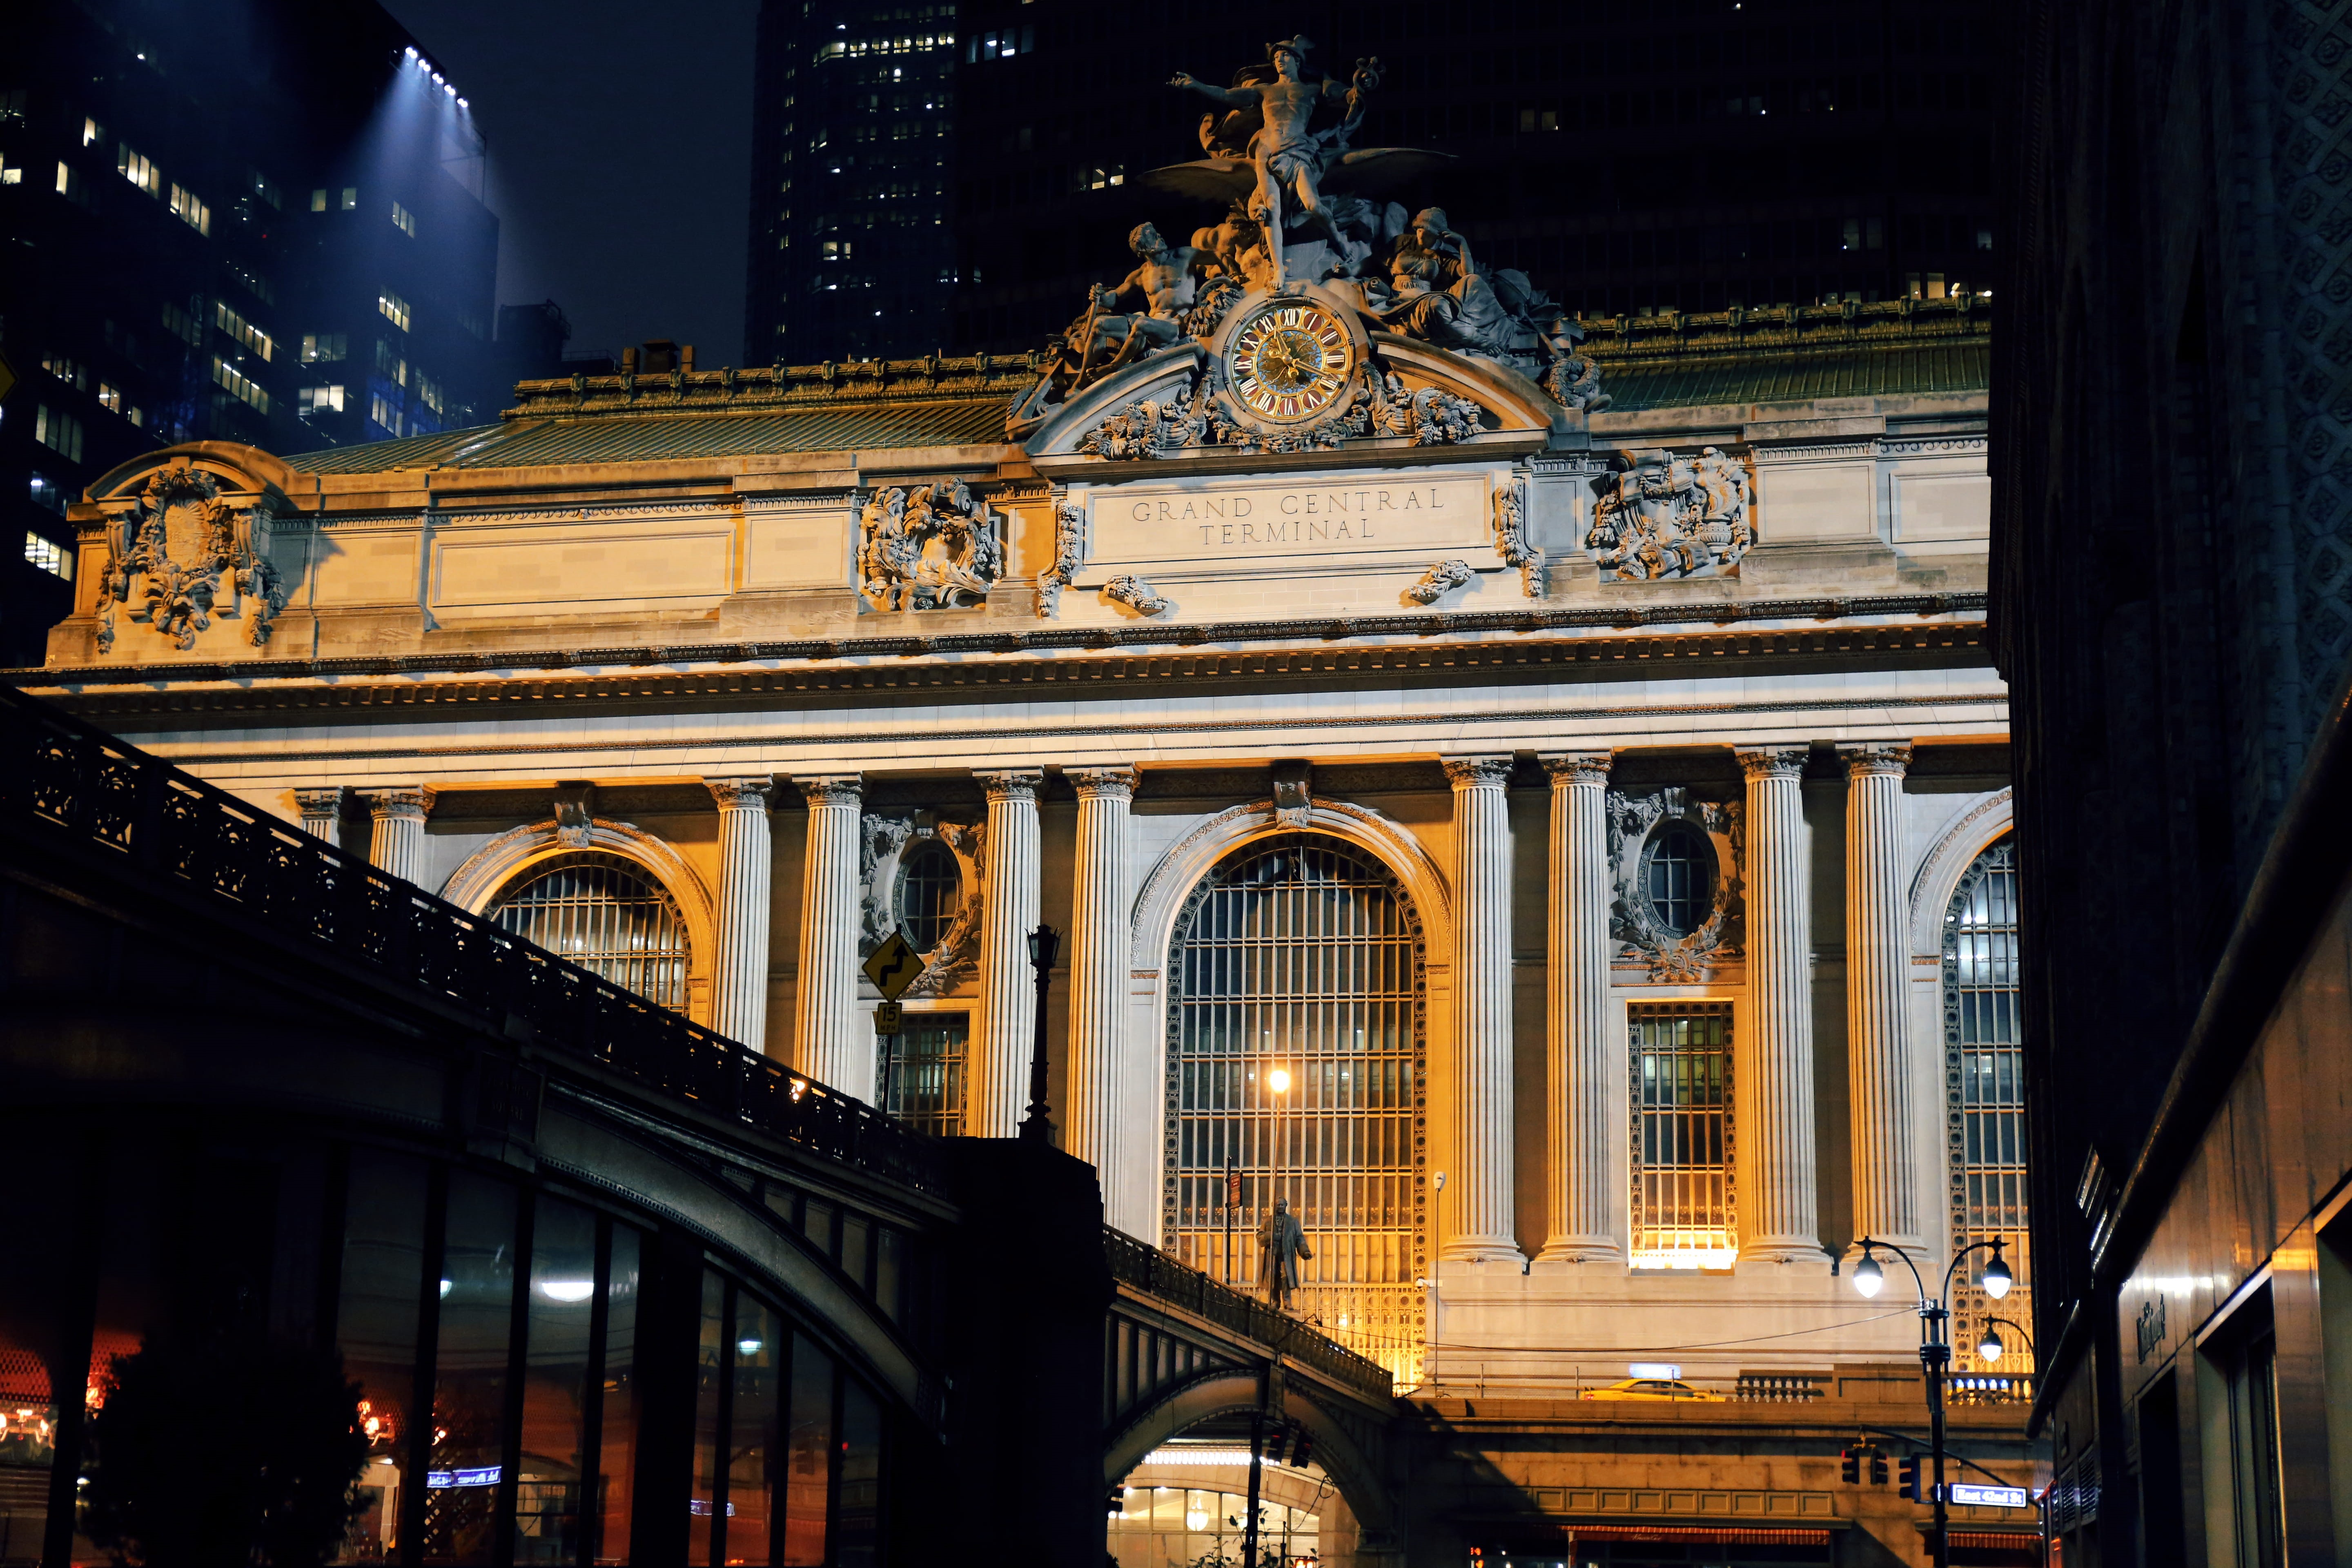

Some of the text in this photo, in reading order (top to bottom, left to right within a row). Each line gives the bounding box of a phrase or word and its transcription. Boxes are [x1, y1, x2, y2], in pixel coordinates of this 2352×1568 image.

[1241, 335, 1259, 348] X
[1132, 488, 1444, 522] GRAND CENTRAL
[1199, 518, 1375, 545] TERMINAL
[883, 1007, 896, 1022] 15
[1957, 1489, 2022, 1503] East 42nd St
